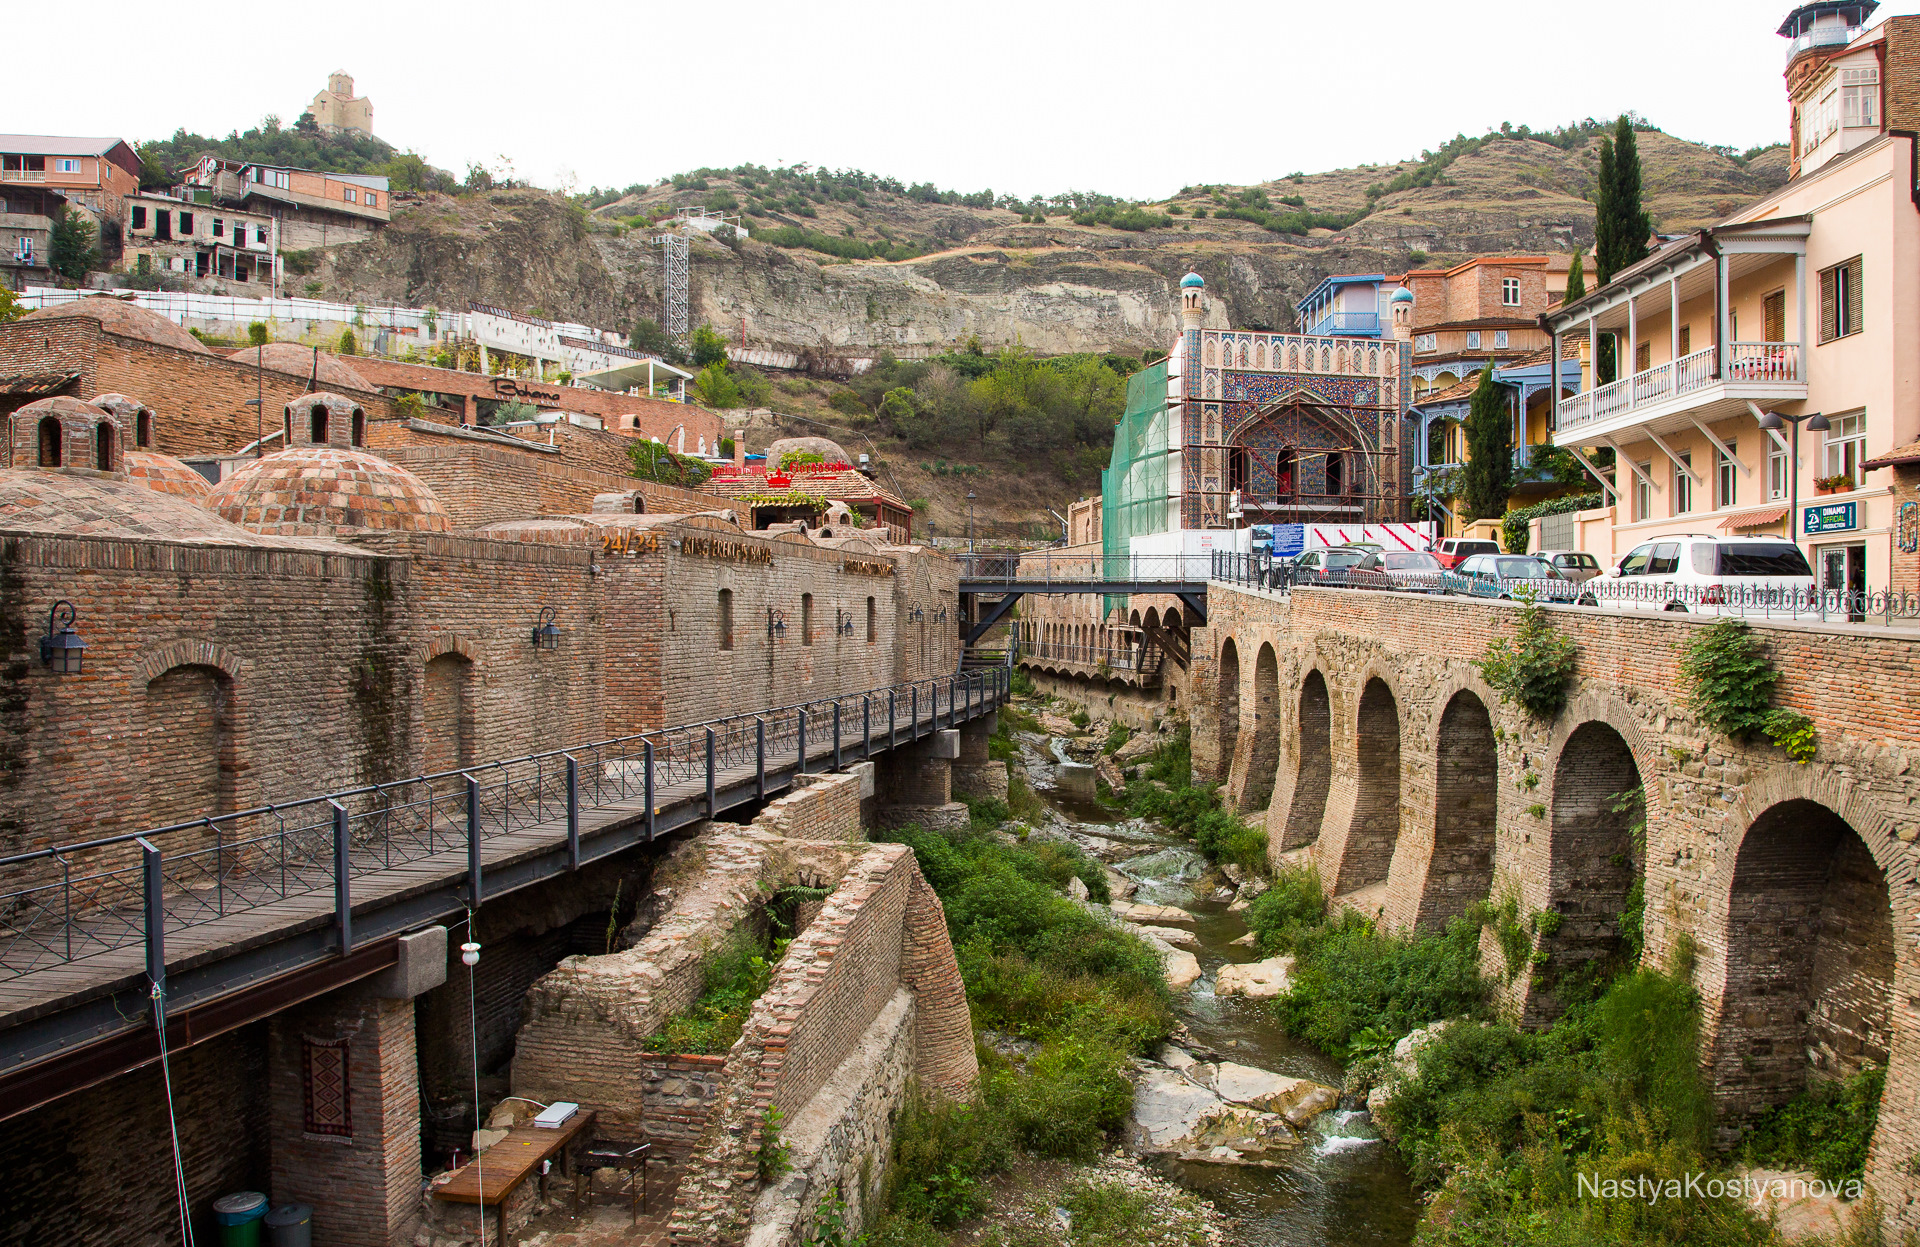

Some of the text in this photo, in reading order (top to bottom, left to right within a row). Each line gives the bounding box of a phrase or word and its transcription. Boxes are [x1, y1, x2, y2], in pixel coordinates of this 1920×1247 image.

[489, 378, 560, 400] Bohema
[1822, 505, 1846, 516] DINAMO
[1822, 515, 1846, 524] OFFICIAL
[1822, 522, 1846, 530] PRODUCTION
[600, 531, 659, 555] 24/24
[683, 536, 709, 556] KING
